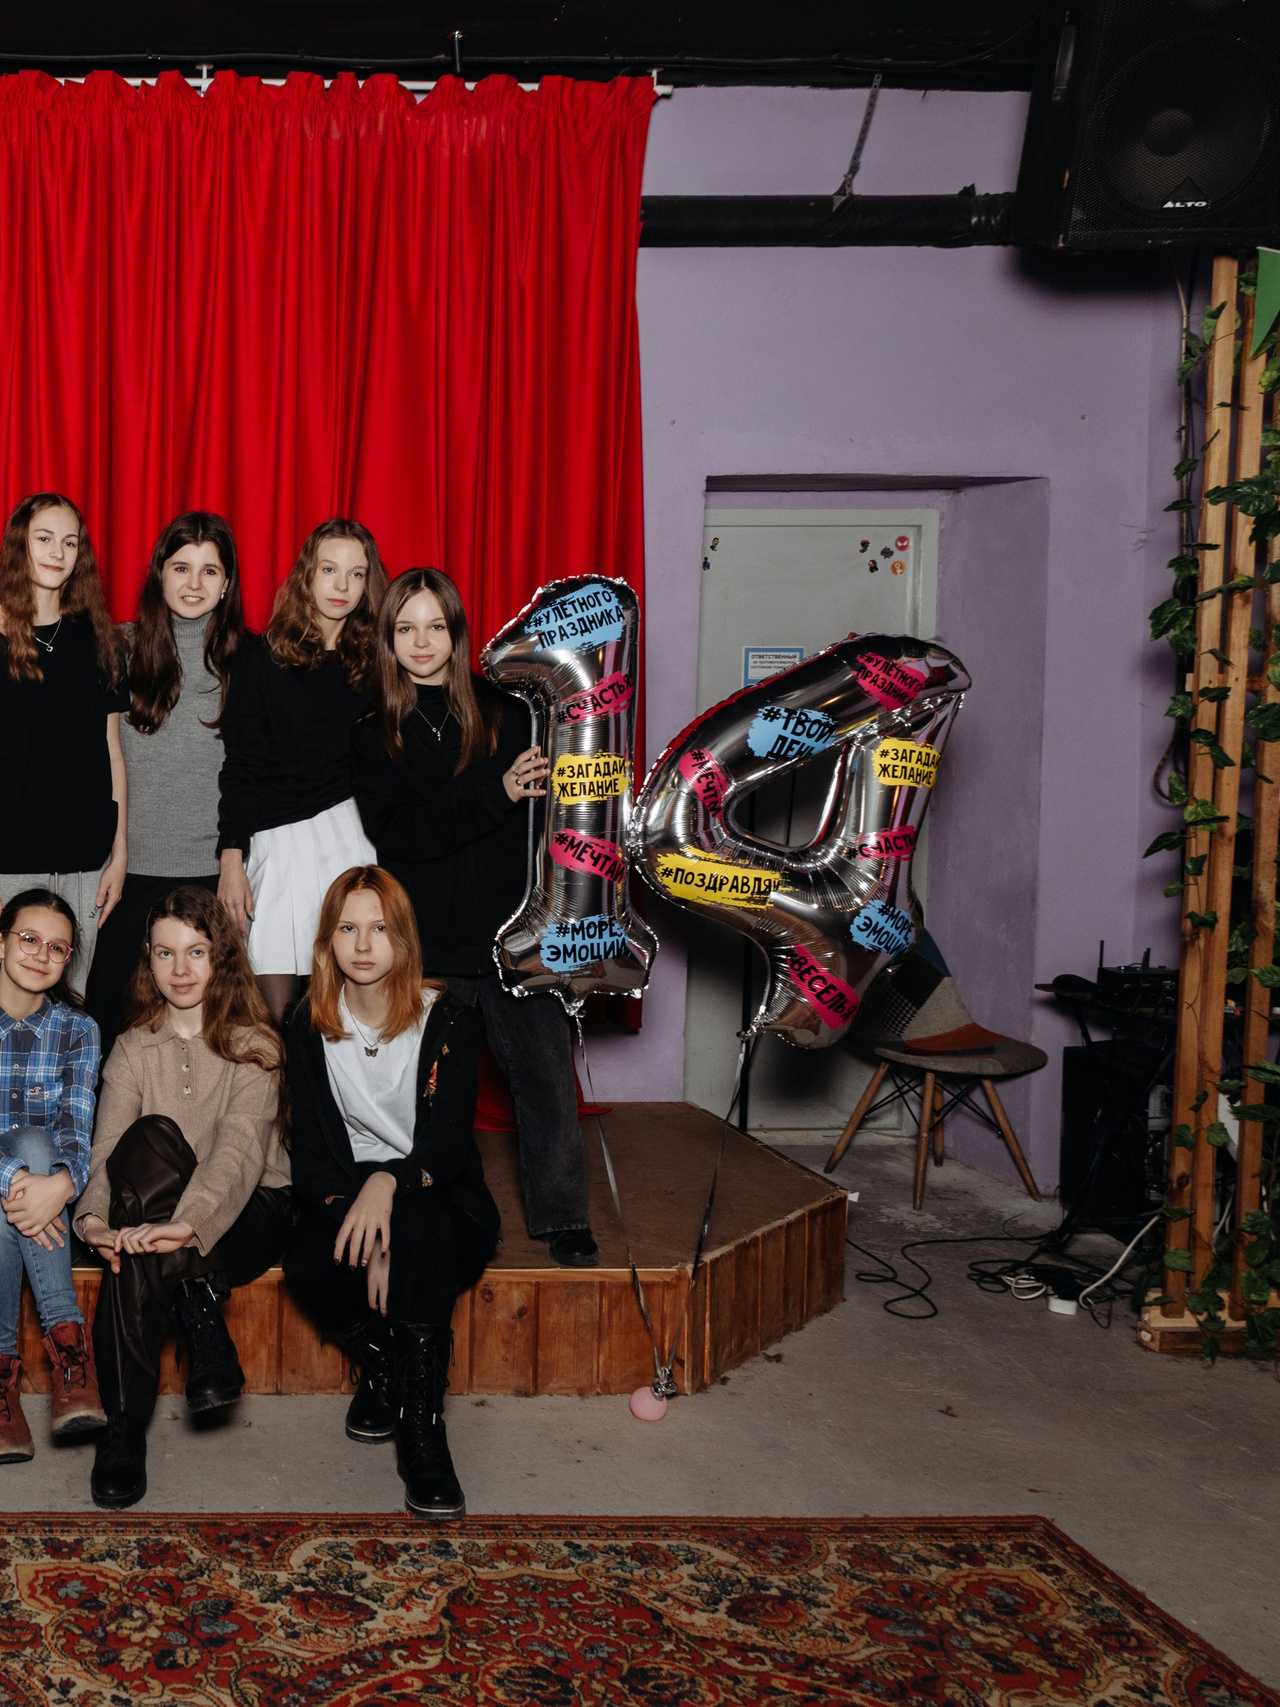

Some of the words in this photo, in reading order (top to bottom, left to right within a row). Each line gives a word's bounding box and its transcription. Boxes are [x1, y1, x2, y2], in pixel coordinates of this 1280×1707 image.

[537, 605, 625, 649] ПРАЗДНИКА
[557, 673, 633, 724] #СЧАСТЬЯ
[765, 733, 815, 762] ДЕНЬ
[557, 777, 620, 798] ЖЕЛАНИЕ
[877, 763, 934, 785] ЖЕЛАНИЕ
[554, 832, 626, 883] #МЕЧТАЙ
[555, 919, 619, 941] #МОРЕ
[878, 903, 916, 945] #МОРЕ
